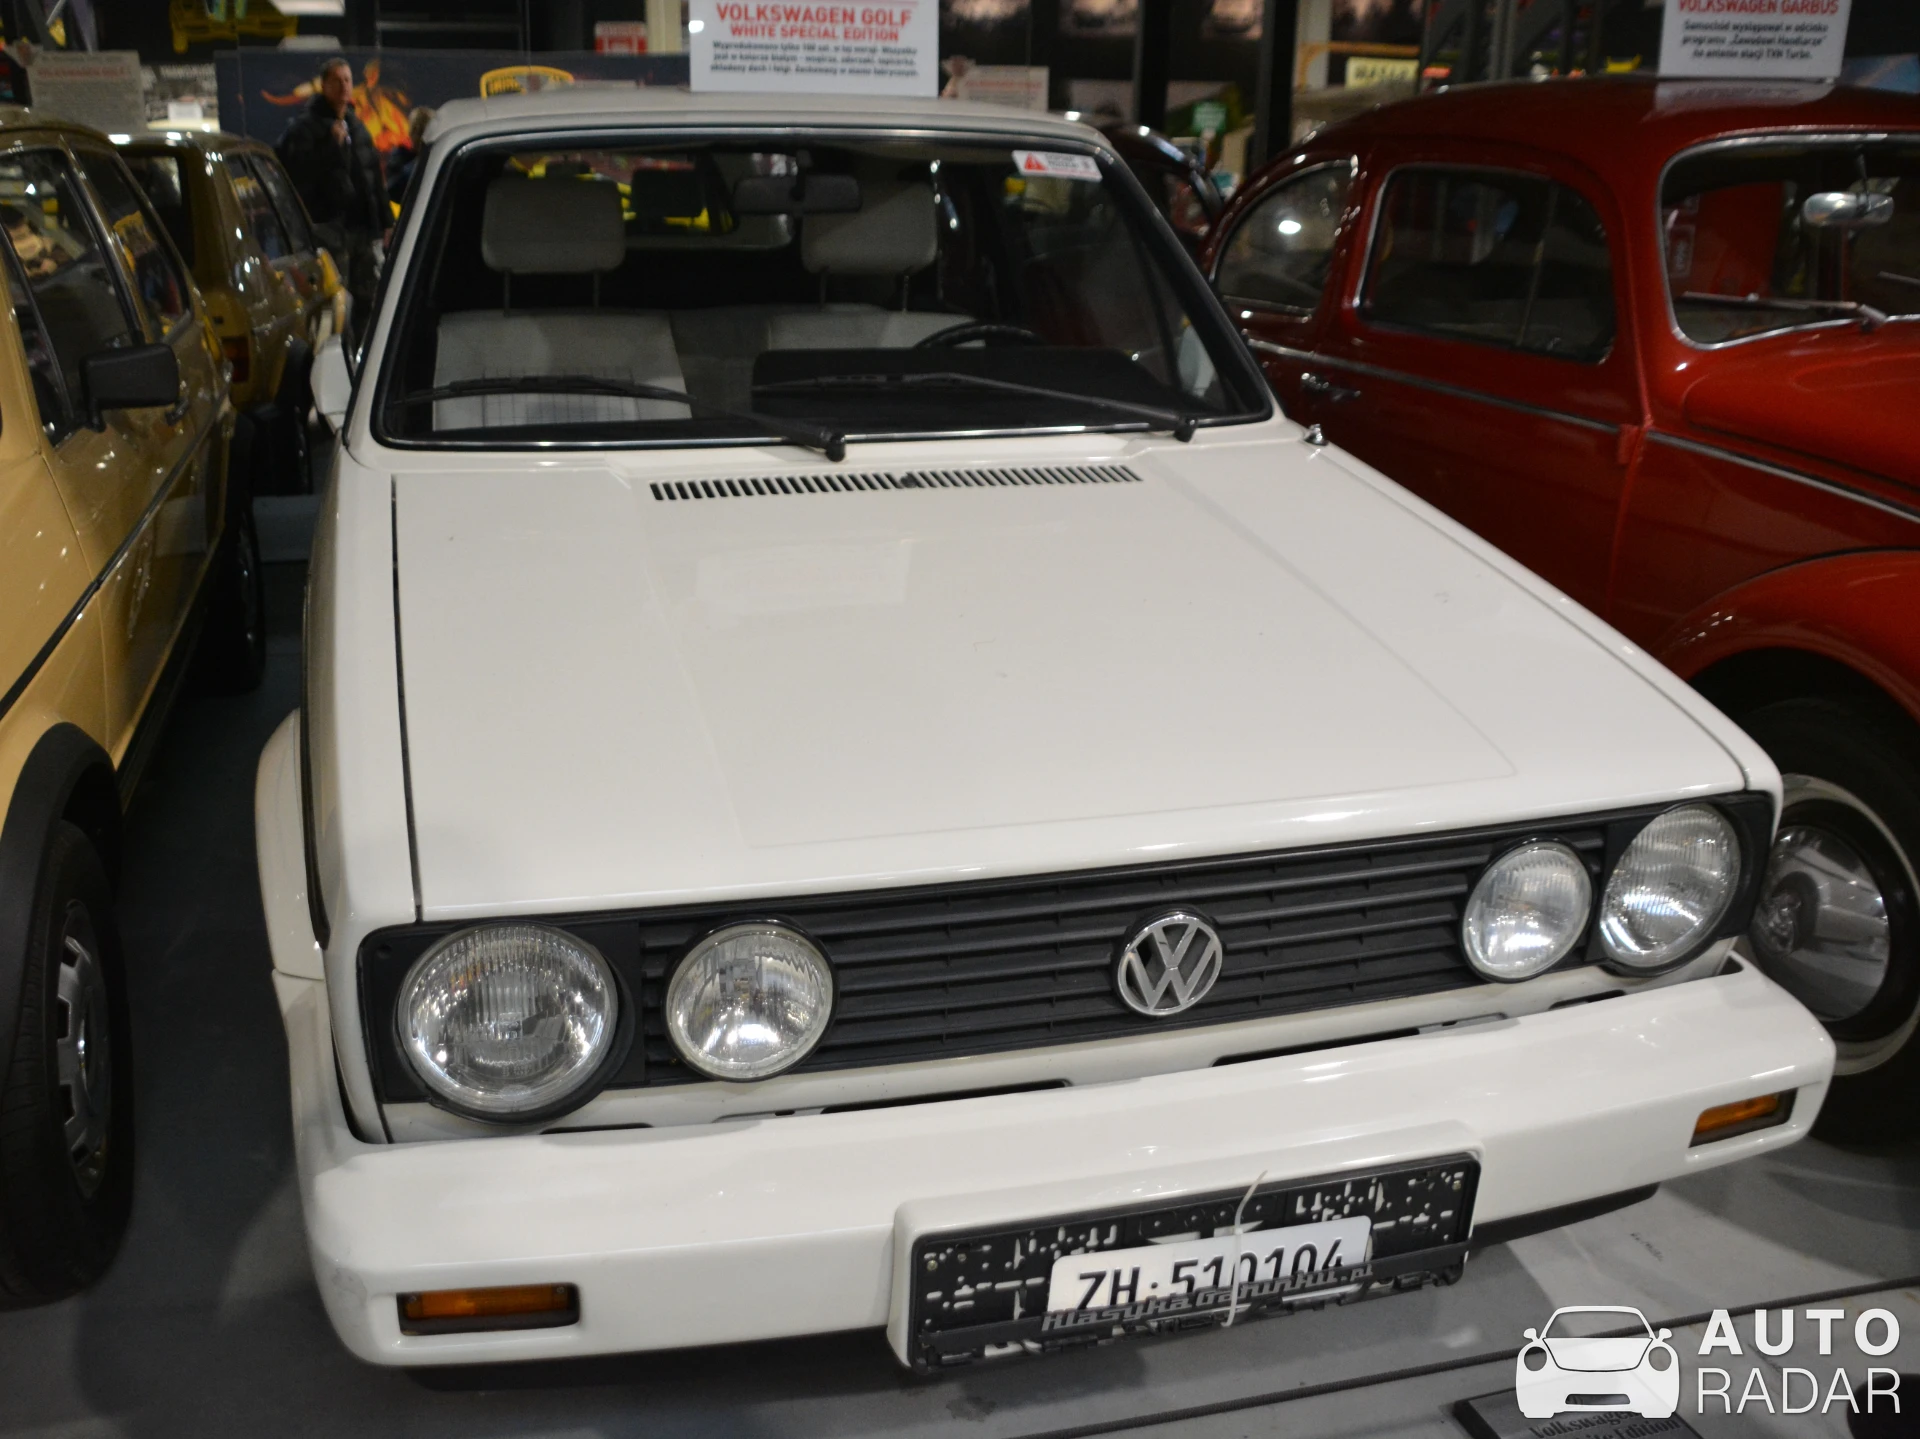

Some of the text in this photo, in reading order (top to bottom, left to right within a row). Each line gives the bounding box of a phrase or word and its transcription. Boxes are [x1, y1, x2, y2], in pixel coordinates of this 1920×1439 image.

[716, 4, 913, 28] VOLKSWAGEN GOLF
[1679, 0, 1840, 15] VOLKSWAGEN GARBUS
[731, 24, 899, 42] WHITE SPECIAL EDITION
